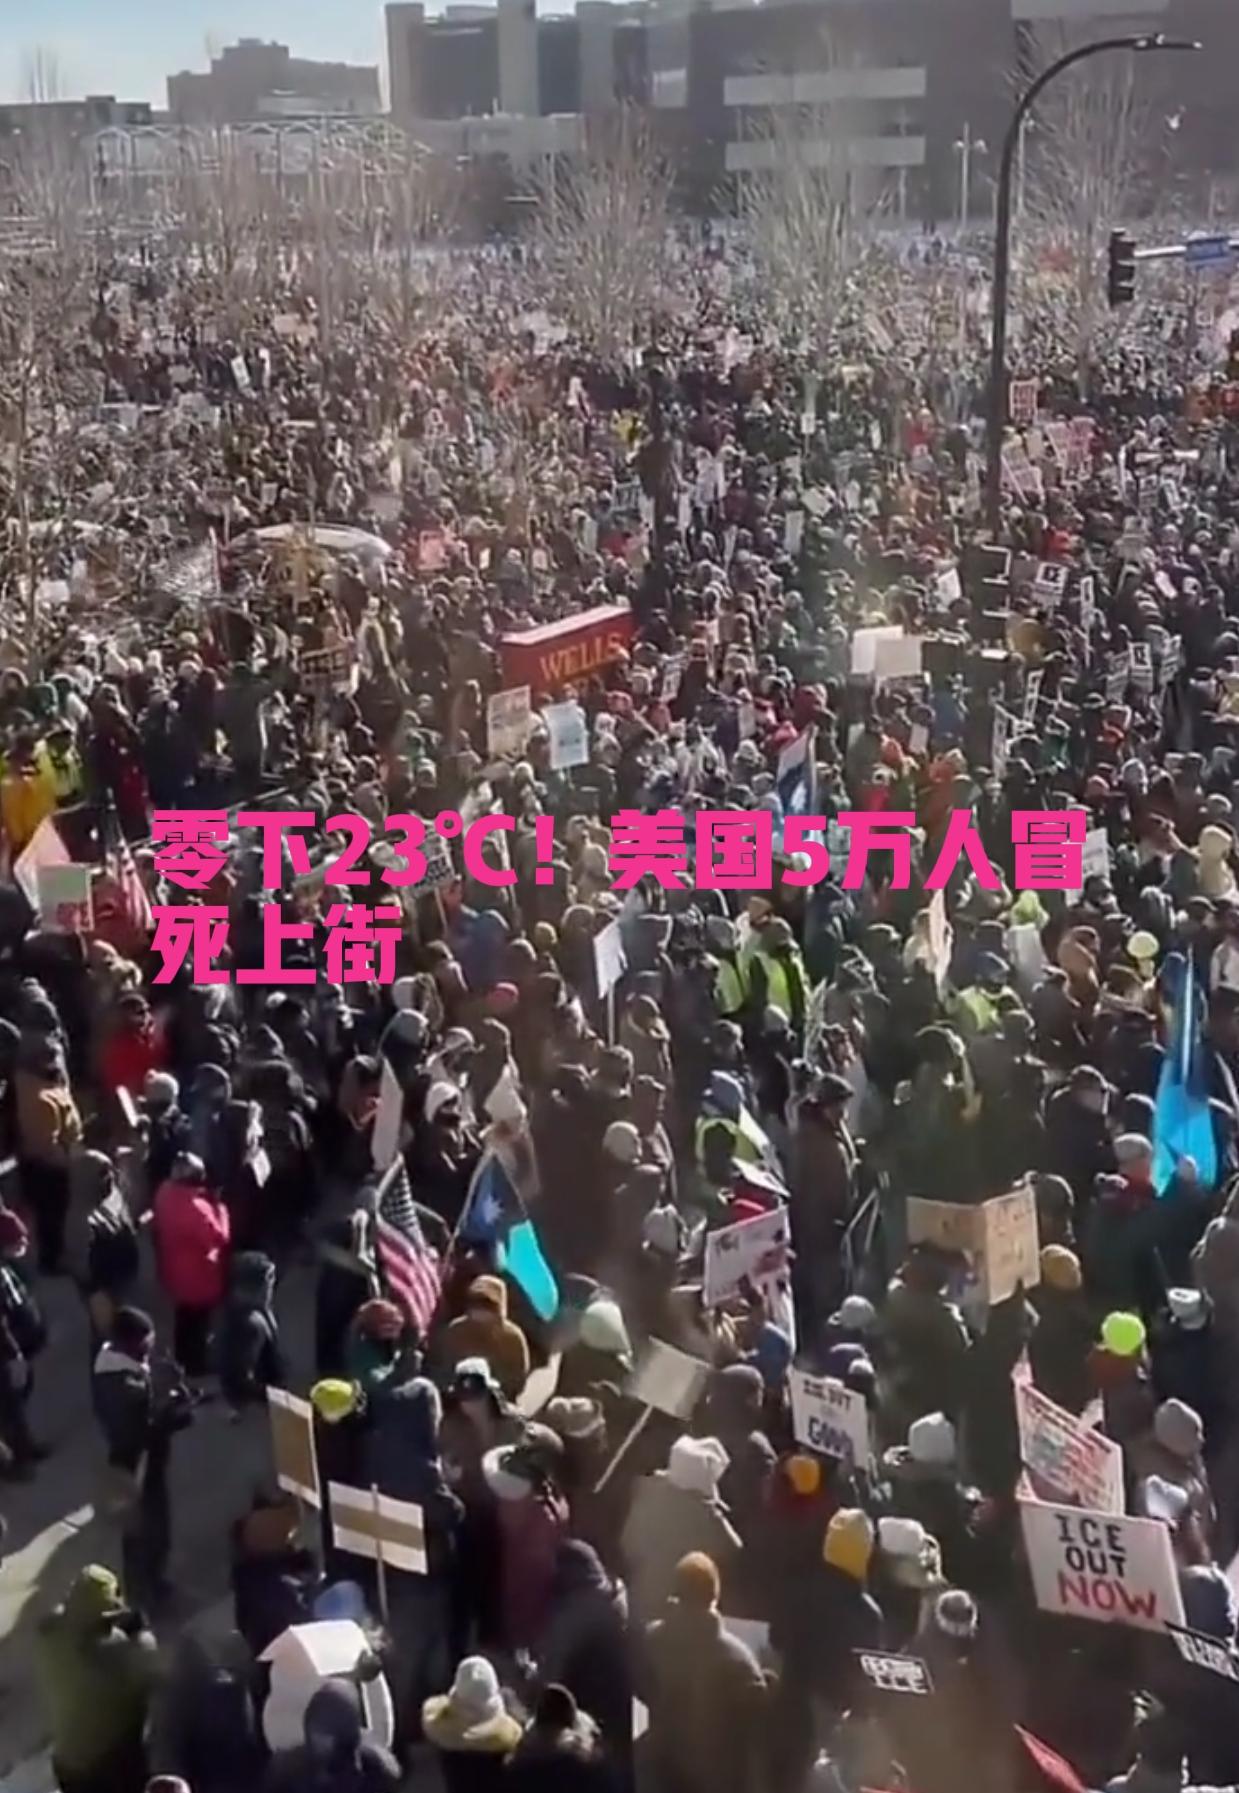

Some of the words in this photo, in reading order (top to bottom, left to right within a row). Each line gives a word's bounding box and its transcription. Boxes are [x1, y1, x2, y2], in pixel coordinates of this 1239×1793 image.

[540, 632, 624, 681] WELLS
[1055, 1513, 1126, 1553] ICE
[1065, 1546, 1126, 1578] OUT
[1057, 1571, 1157, 1619] NOW
